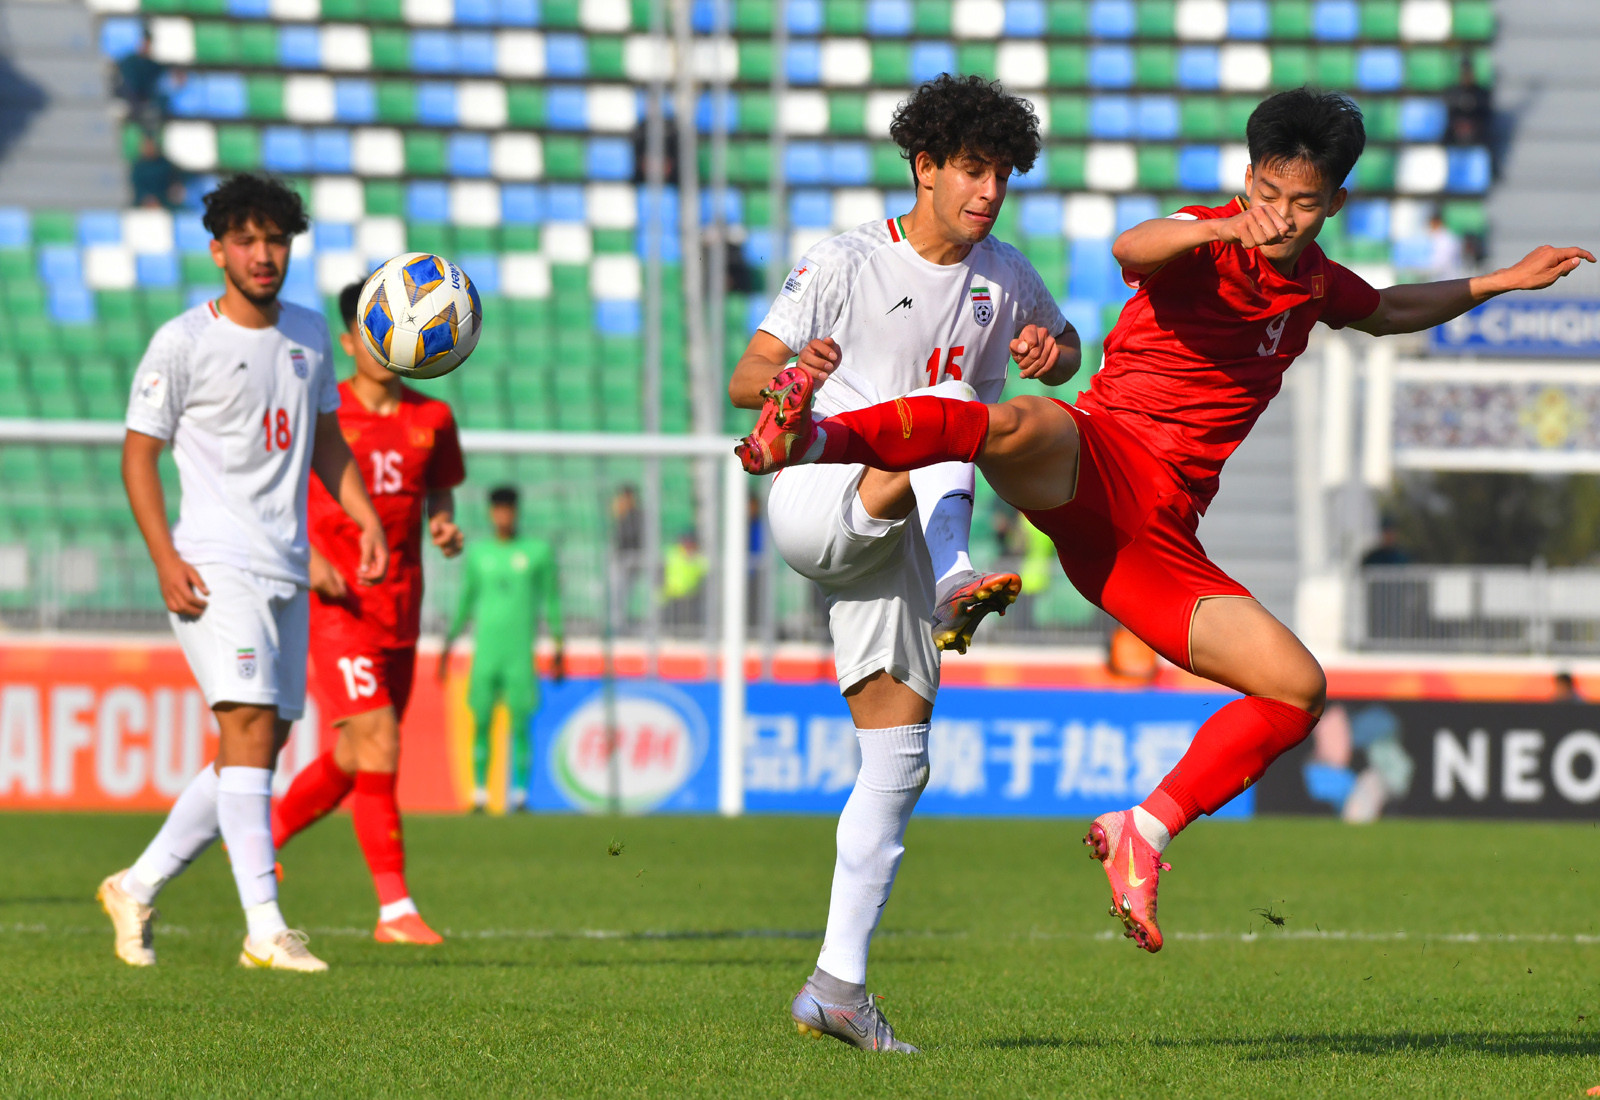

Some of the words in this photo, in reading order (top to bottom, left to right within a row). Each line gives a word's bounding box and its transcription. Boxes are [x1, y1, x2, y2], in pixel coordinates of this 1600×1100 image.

[1257, 308, 1291, 357] 9
[925, 345, 965, 388] 15
[262, 407, 293, 452] 18
[1432, 728, 1600, 803] NEO
